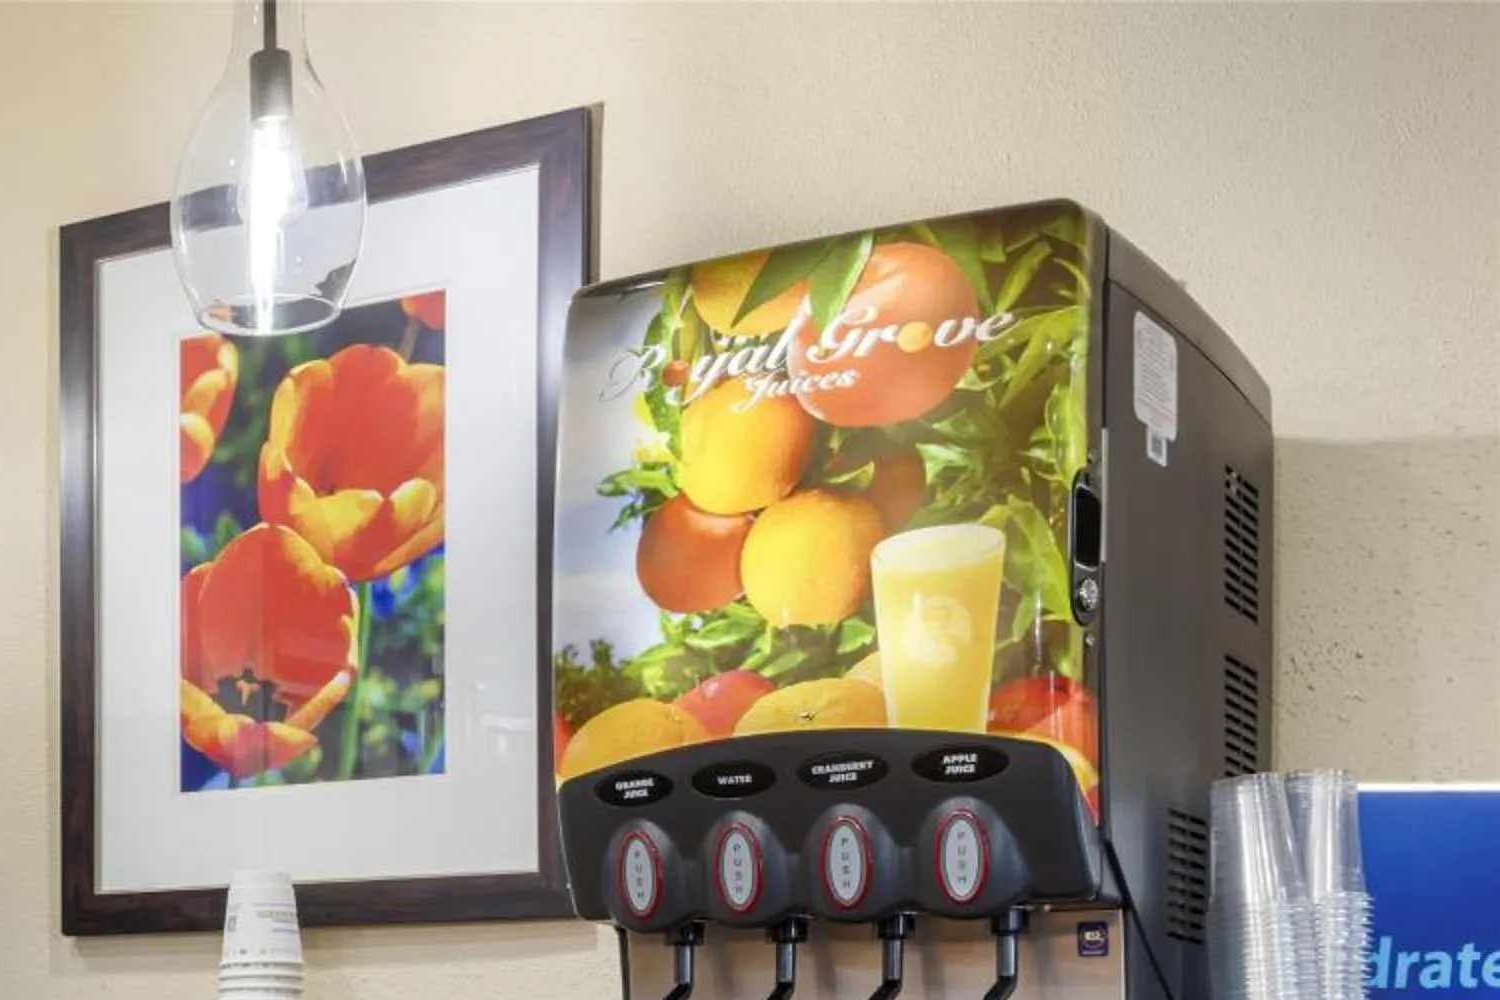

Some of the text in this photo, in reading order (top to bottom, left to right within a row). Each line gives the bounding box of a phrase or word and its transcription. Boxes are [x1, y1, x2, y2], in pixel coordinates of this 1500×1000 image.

[942, 753, 978, 765] APPLE
[944, 763, 976, 775] JUICE
[717, 774, 753, 786] WATER
[828, 772, 858, 783] JUICE
